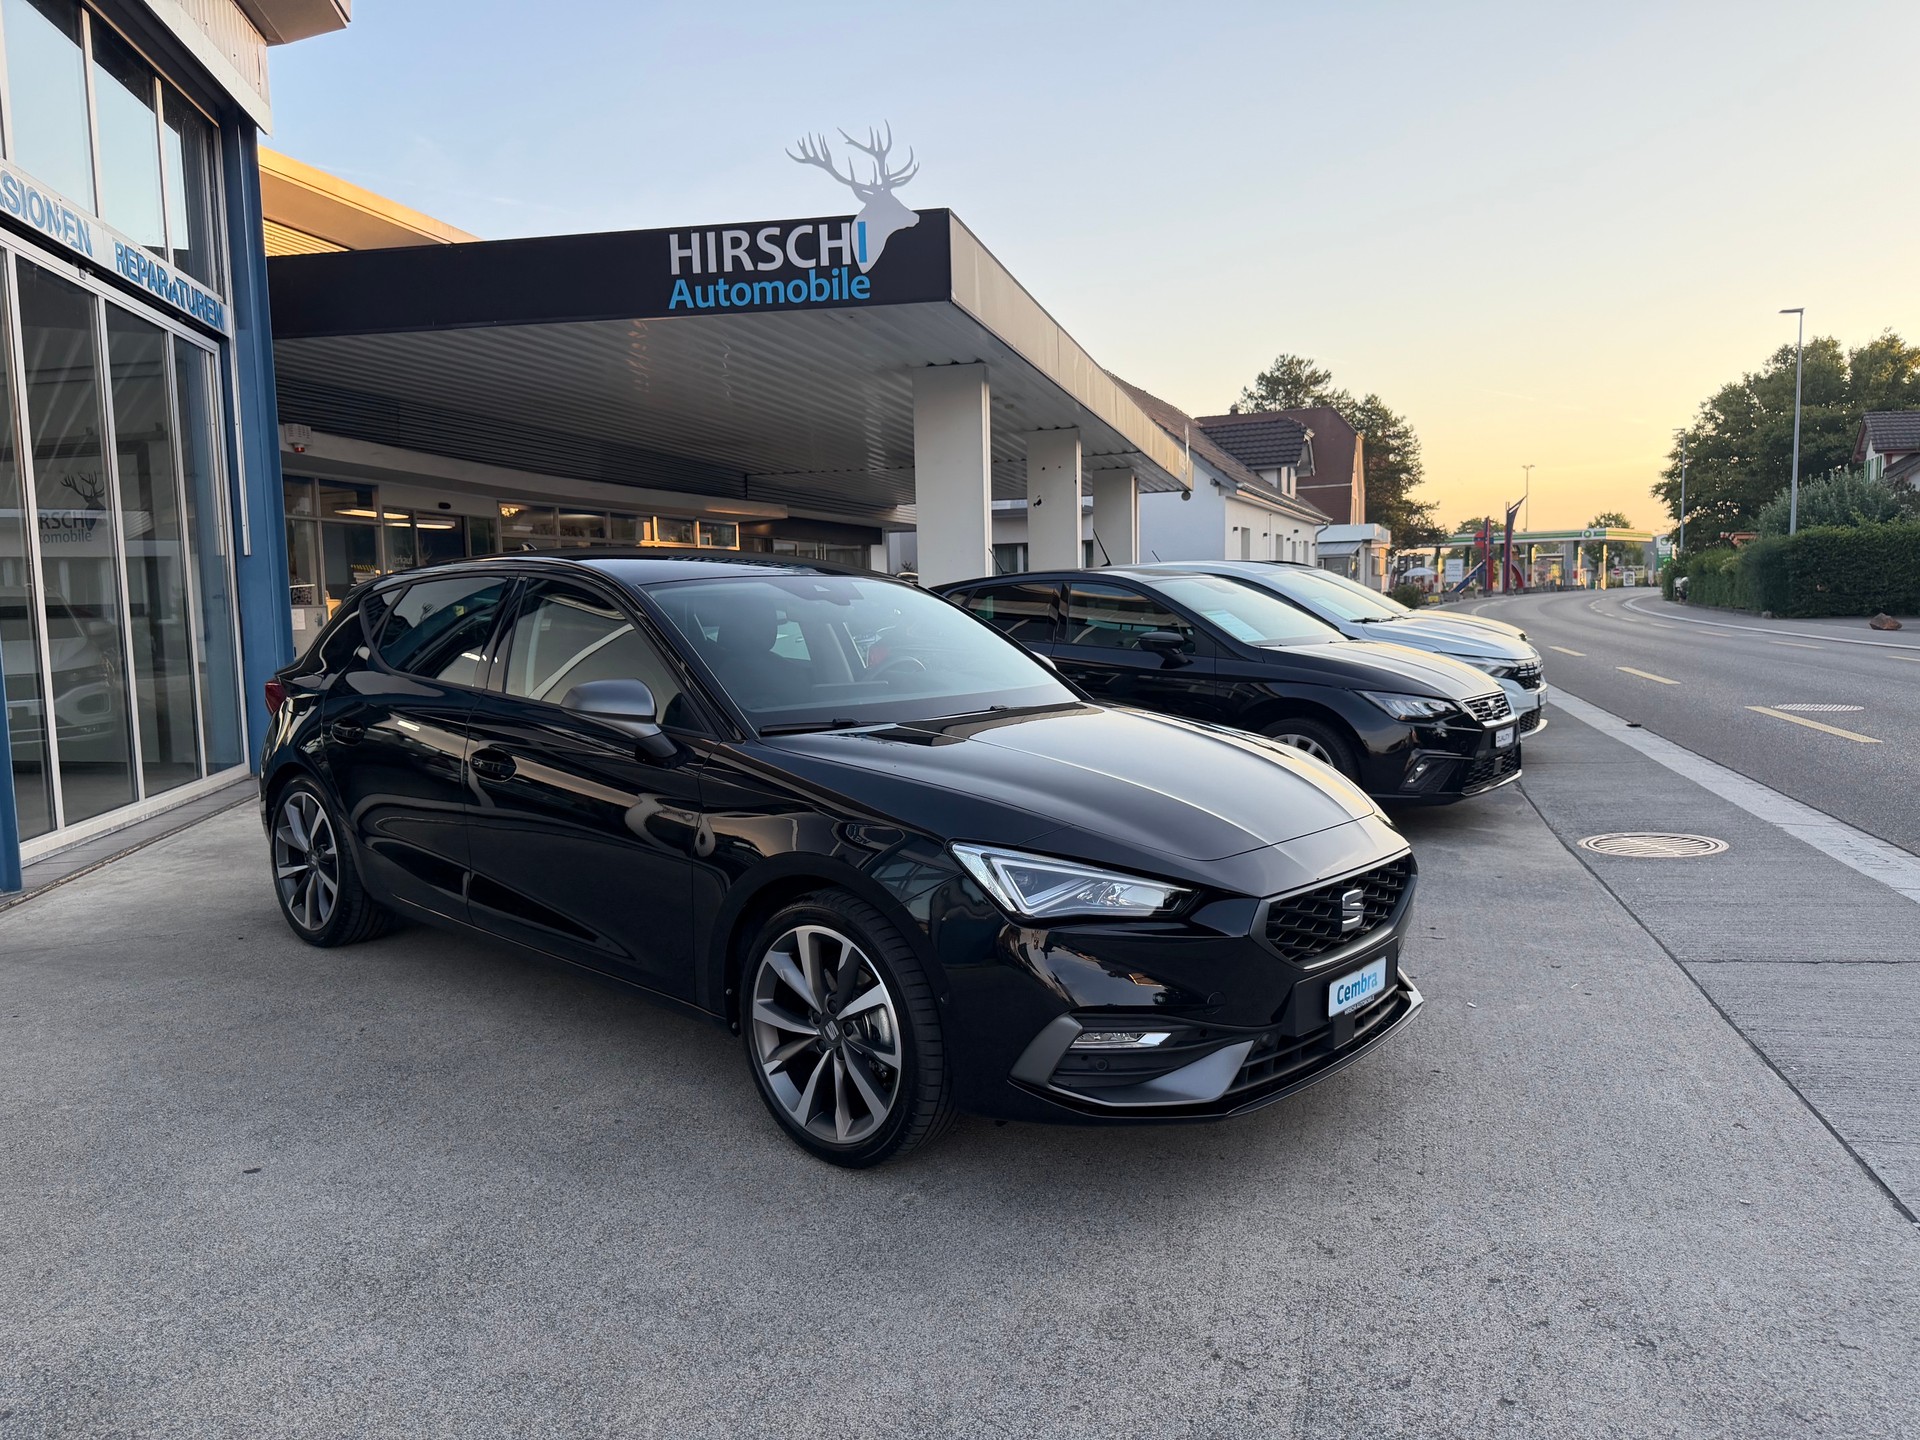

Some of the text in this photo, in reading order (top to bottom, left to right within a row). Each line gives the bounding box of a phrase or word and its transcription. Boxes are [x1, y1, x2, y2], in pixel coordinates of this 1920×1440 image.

[0, 171, 224, 332] SIONEN REPARATUREN
[669, 221, 868, 275] HIRSCHI
[668, 267, 871, 310] Automobile
[40, 529, 92, 543] tomobile
[1337, 972, 1377, 1005] Cembra
